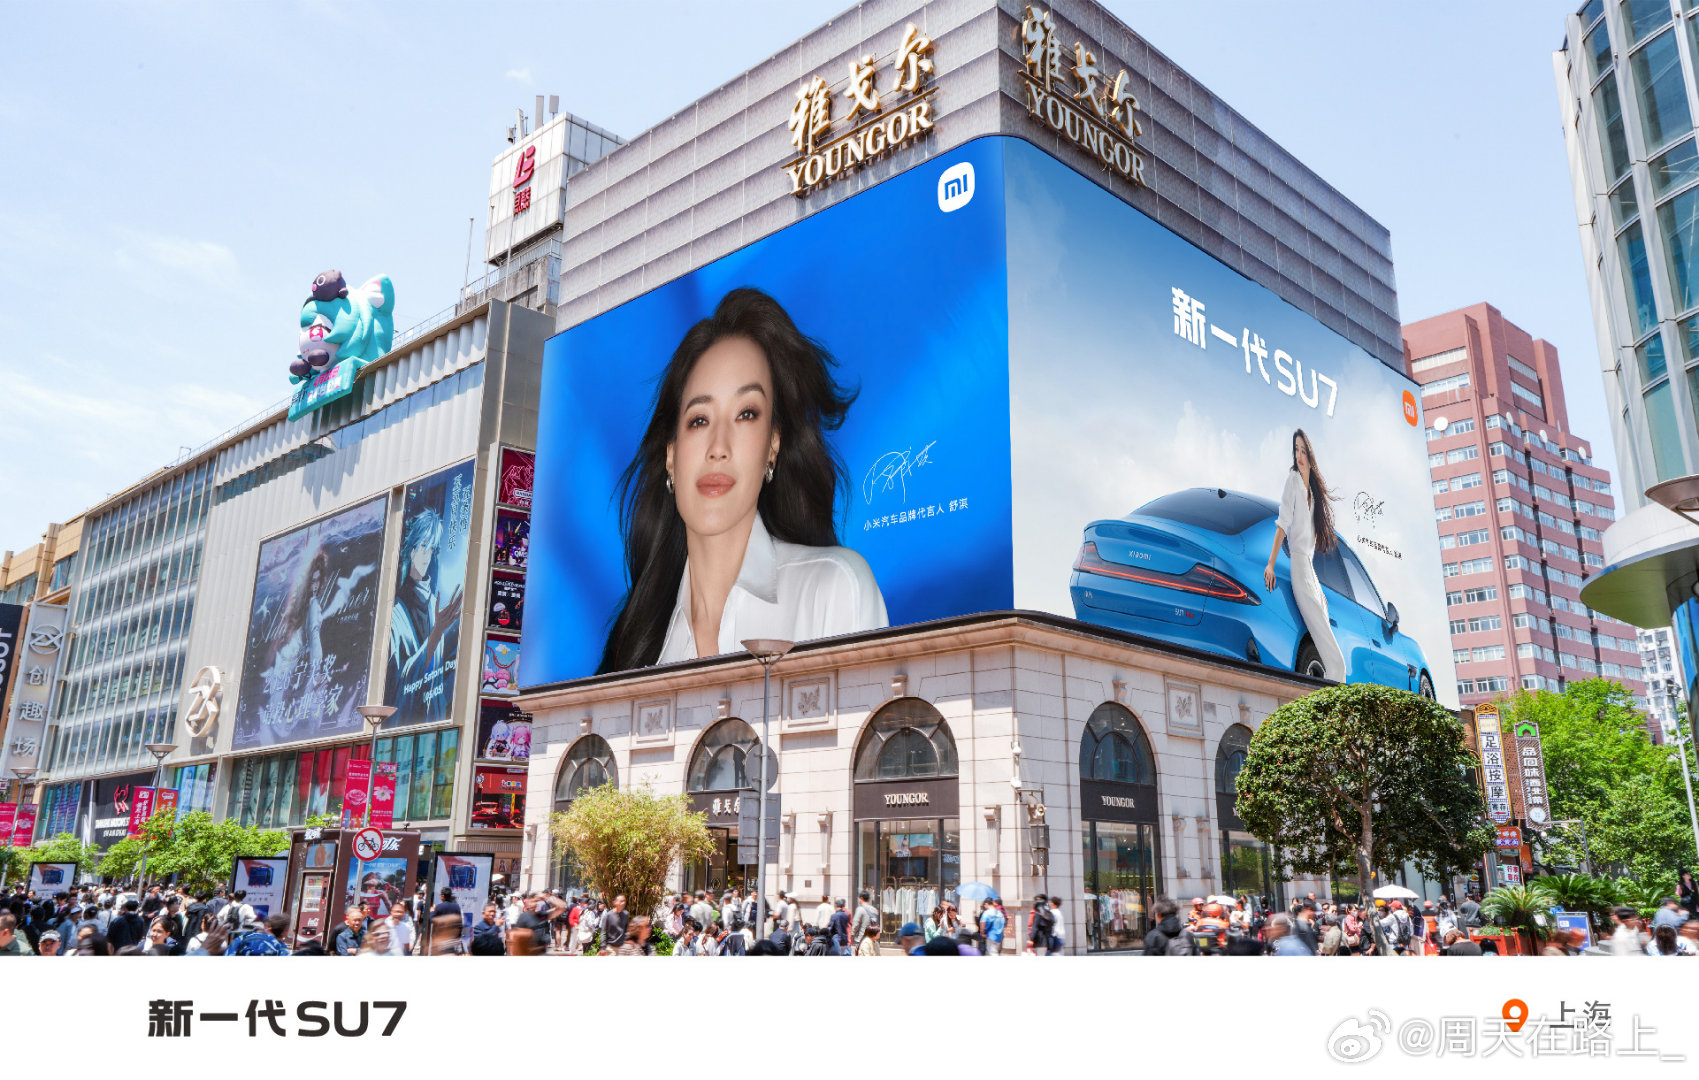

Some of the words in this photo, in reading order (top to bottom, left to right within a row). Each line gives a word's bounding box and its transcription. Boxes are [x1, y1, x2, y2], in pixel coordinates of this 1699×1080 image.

[788, 21, 934, 155] 雅戈尔
[1021, 5, 1143, 139] 雅戈尔
[787, 101, 935, 195] YOUNGOR
[1025, 80, 1148, 187] YOUNGOR
[13, 665, 53, 758] 创趣场
[403, 678, 424, 695] Happy
[884, 792, 930, 805] YOUNGOR
[1101, 795, 1136, 809] YOUNGOR
[1485, 735, 1505, 799] 足浴按摩
